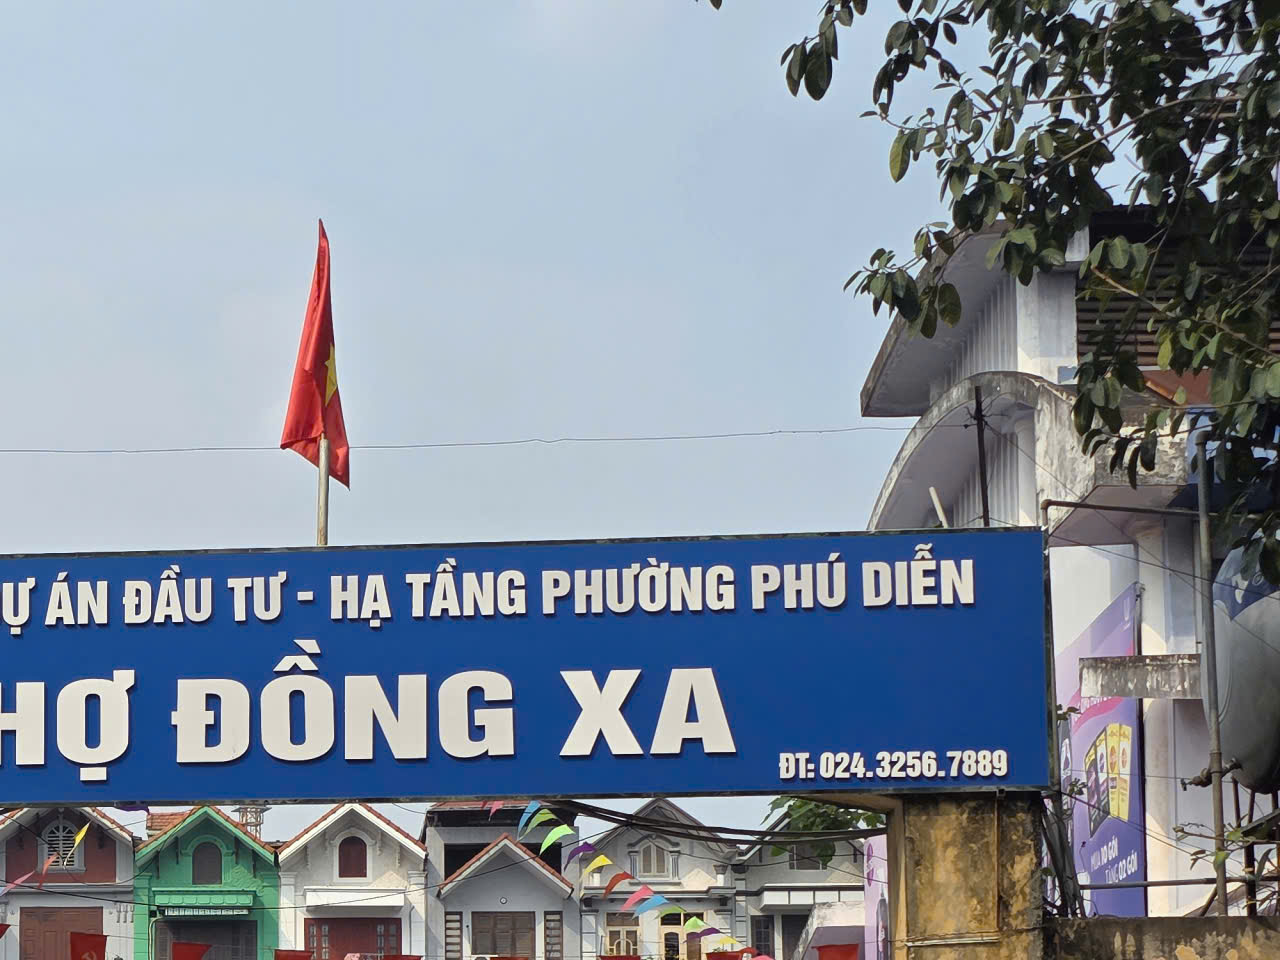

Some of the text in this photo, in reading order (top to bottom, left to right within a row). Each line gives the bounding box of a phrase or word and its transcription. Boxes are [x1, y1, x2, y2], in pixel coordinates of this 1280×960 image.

[45, 572, 109, 626] ÁN
[123, 565, 212, 625] ĐẦU
[228, 571, 288, 622] TƯ
[330, 573, 391, 628] HẠ
[406, 557, 528, 618] TẦNG
[543, 562, 736, 615] PHƯỜNG
[752, 552, 846, 610] PHÚ
[863, 543, 975, 606] DIỄN
[171, 639, 515, 764] ĐỒNG
[559, 667, 737, 758] XA
[779, 749, 1009, 780] ĐT: 024.3256.7889
